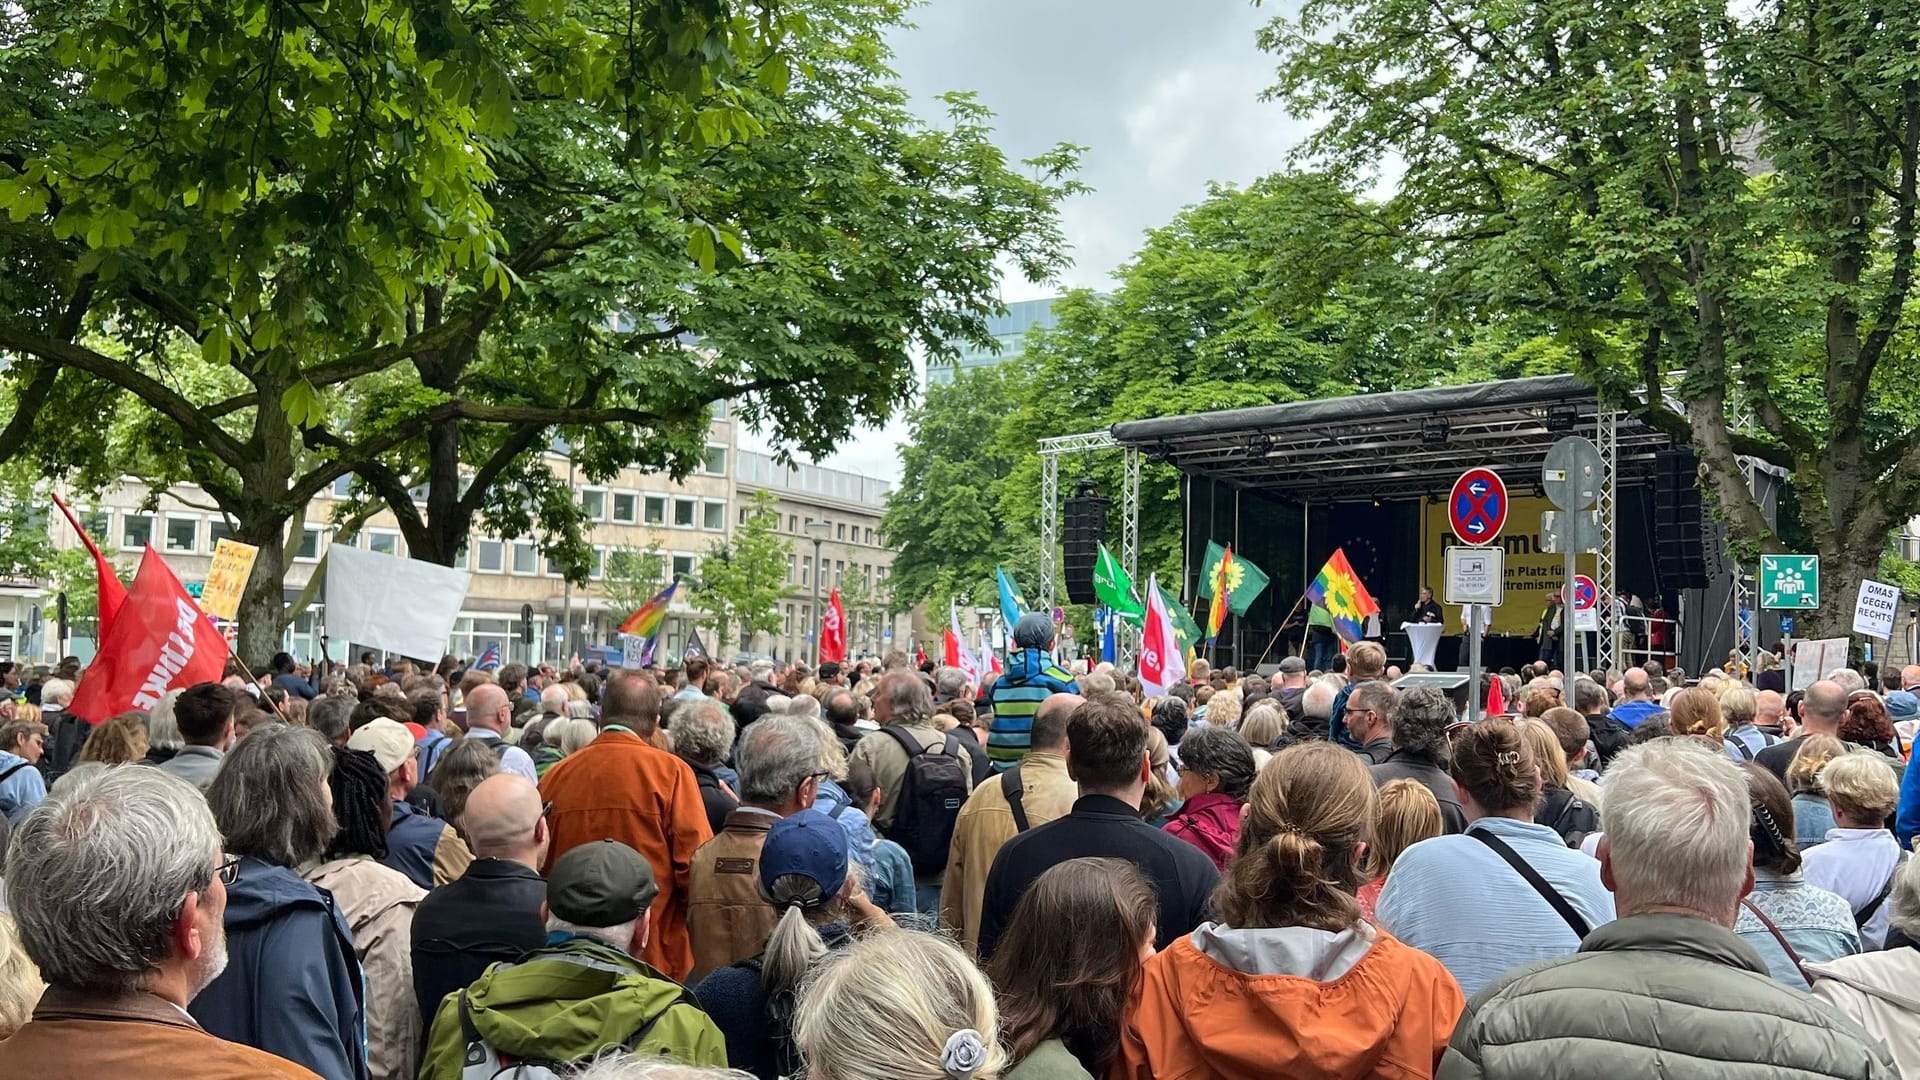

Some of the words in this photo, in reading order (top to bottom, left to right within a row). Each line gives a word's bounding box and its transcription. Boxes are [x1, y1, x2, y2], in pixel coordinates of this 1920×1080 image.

[1518, 566, 1547, 576] Platz
[1868, 585, 1894, 599] OMAS
[1862, 596, 1893, 610] GEGEN
[1857, 607, 1893, 623] RECHTS
